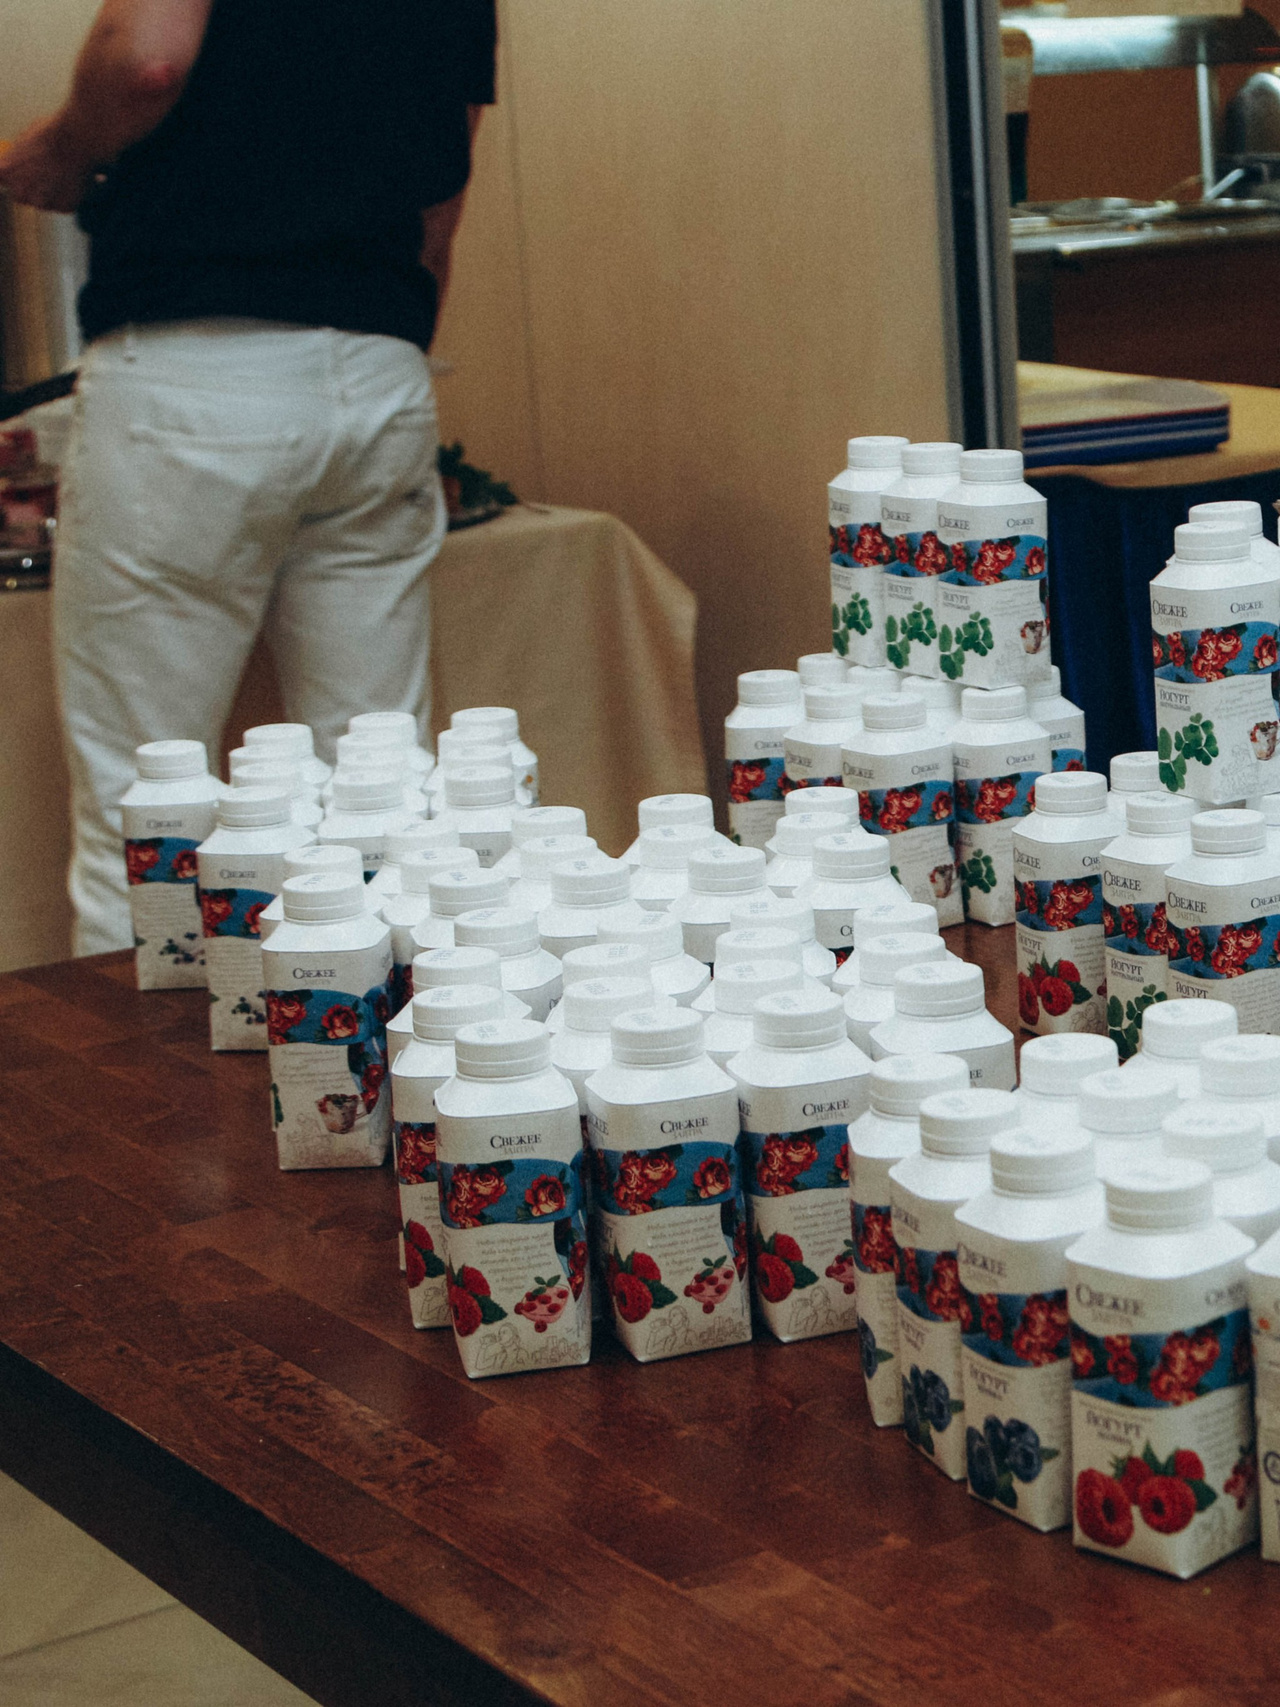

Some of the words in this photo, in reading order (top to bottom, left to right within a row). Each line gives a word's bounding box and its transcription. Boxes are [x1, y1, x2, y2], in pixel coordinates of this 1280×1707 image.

[1152, 600, 1188, 618] СВЕЖЕЕ
[1230, 601, 1264, 614] СВЕЖЕЕ
[1103, 870, 1142, 892] СВЕЖЕЕ
[1167, 891, 1208, 914] СВЕЖЕЕ
[1110, 957, 1144, 976] ЙОГУРТ
[802, 1099, 850, 1117] СВЕЖЕЕ
[660, 1117, 709, 1136] СВЕЖЕЕ
[490, 1133, 542, 1150] СВЕЖЕЕ
